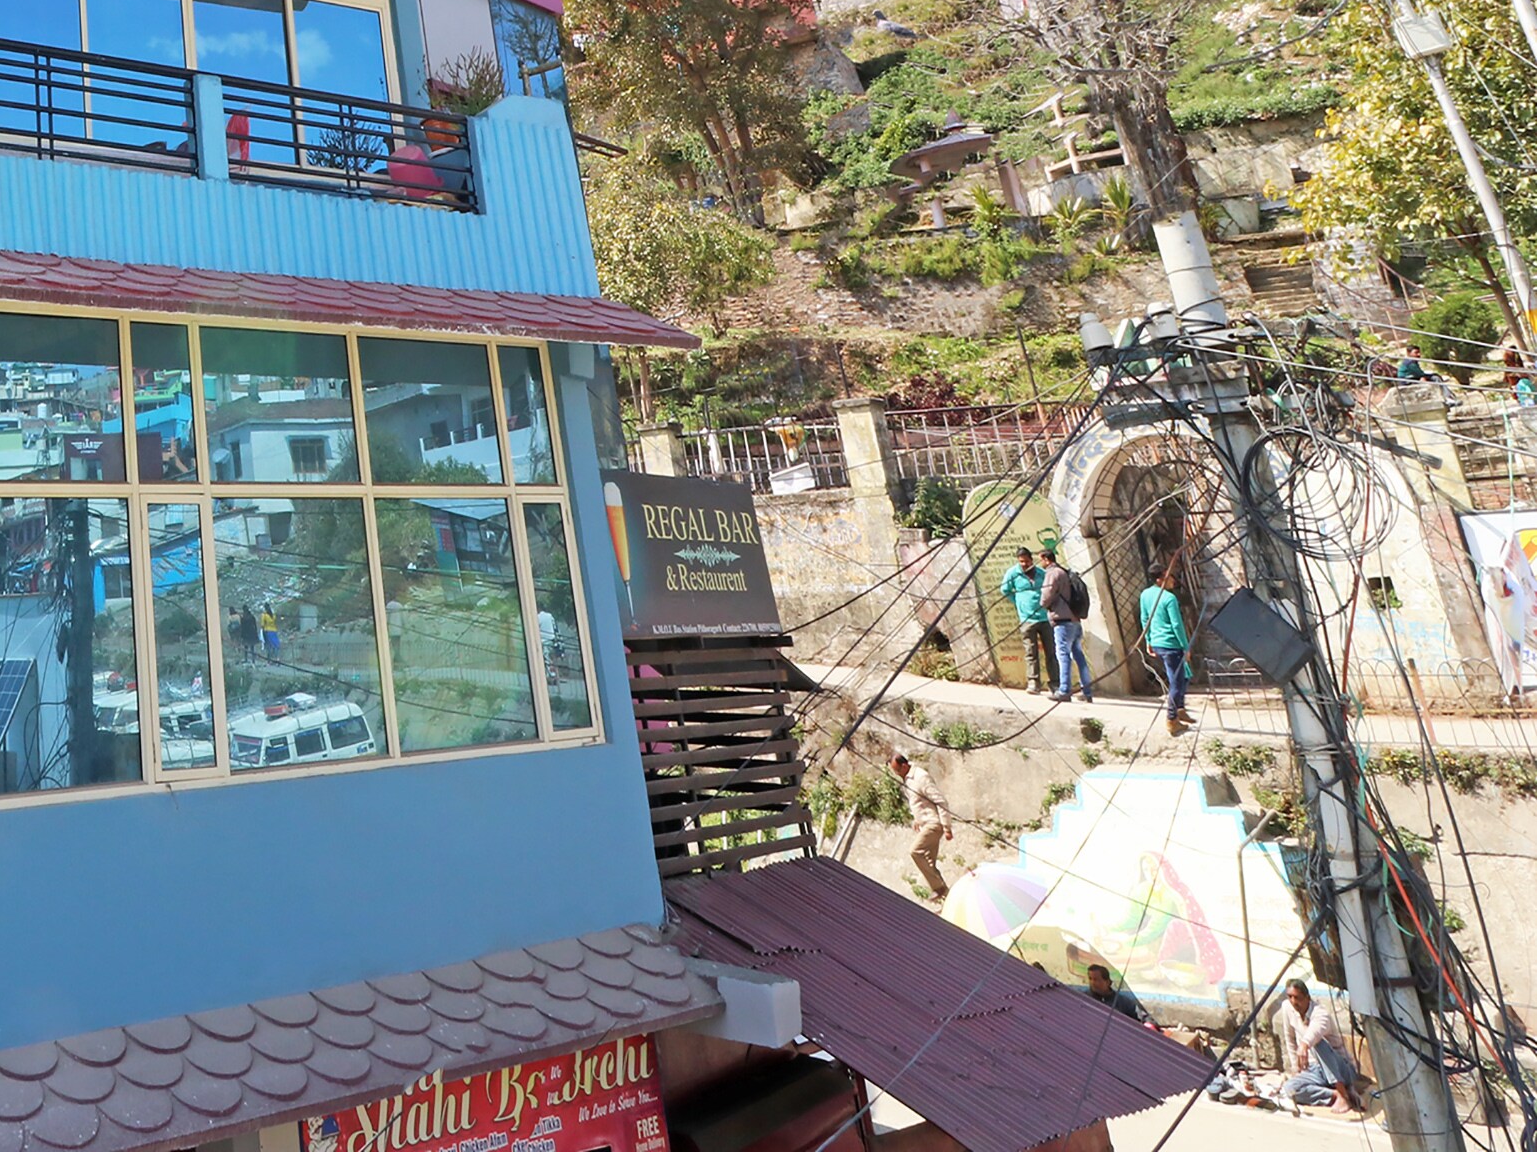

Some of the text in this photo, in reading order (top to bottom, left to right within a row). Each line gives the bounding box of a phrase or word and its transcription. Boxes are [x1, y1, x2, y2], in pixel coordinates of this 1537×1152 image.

[642, 504, 759, 545] REGAL BAR
[666, 564, 747, 592] & Restaurent
[578, 1106, 590, 1123] We
[636, 1115, 660, 1140] FREE
